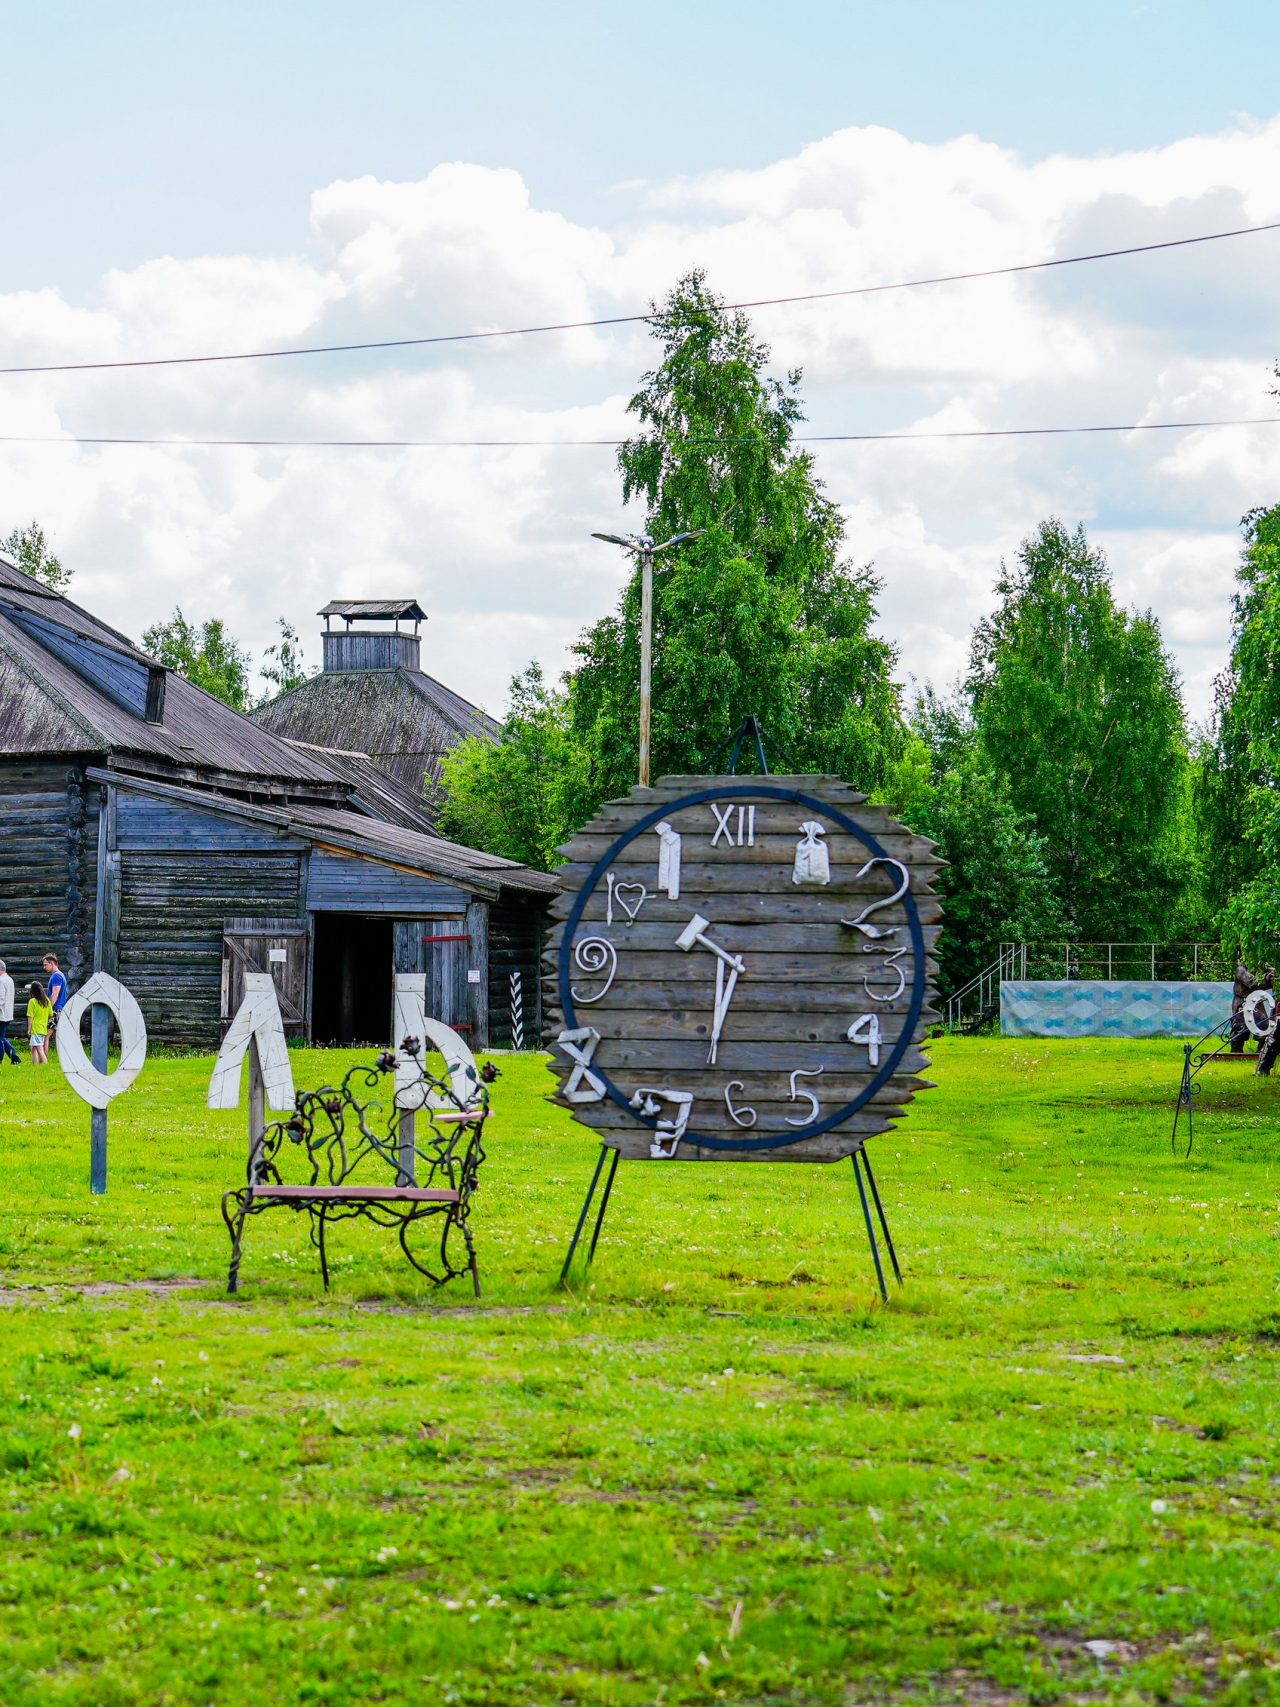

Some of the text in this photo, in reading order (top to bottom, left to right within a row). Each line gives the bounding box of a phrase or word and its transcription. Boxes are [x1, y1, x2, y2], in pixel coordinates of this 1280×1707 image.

[710, 804, 755, 847] XII
[571, 936, 618, 1003] 9
[862, 944, 907, 1002] 3
[557, 1026, 608, 1103] 8
[846, 1013, 883, 1067] 4
[723, 1081, 758, 1128] 6
[785, 1065, 824, 1127] 5
